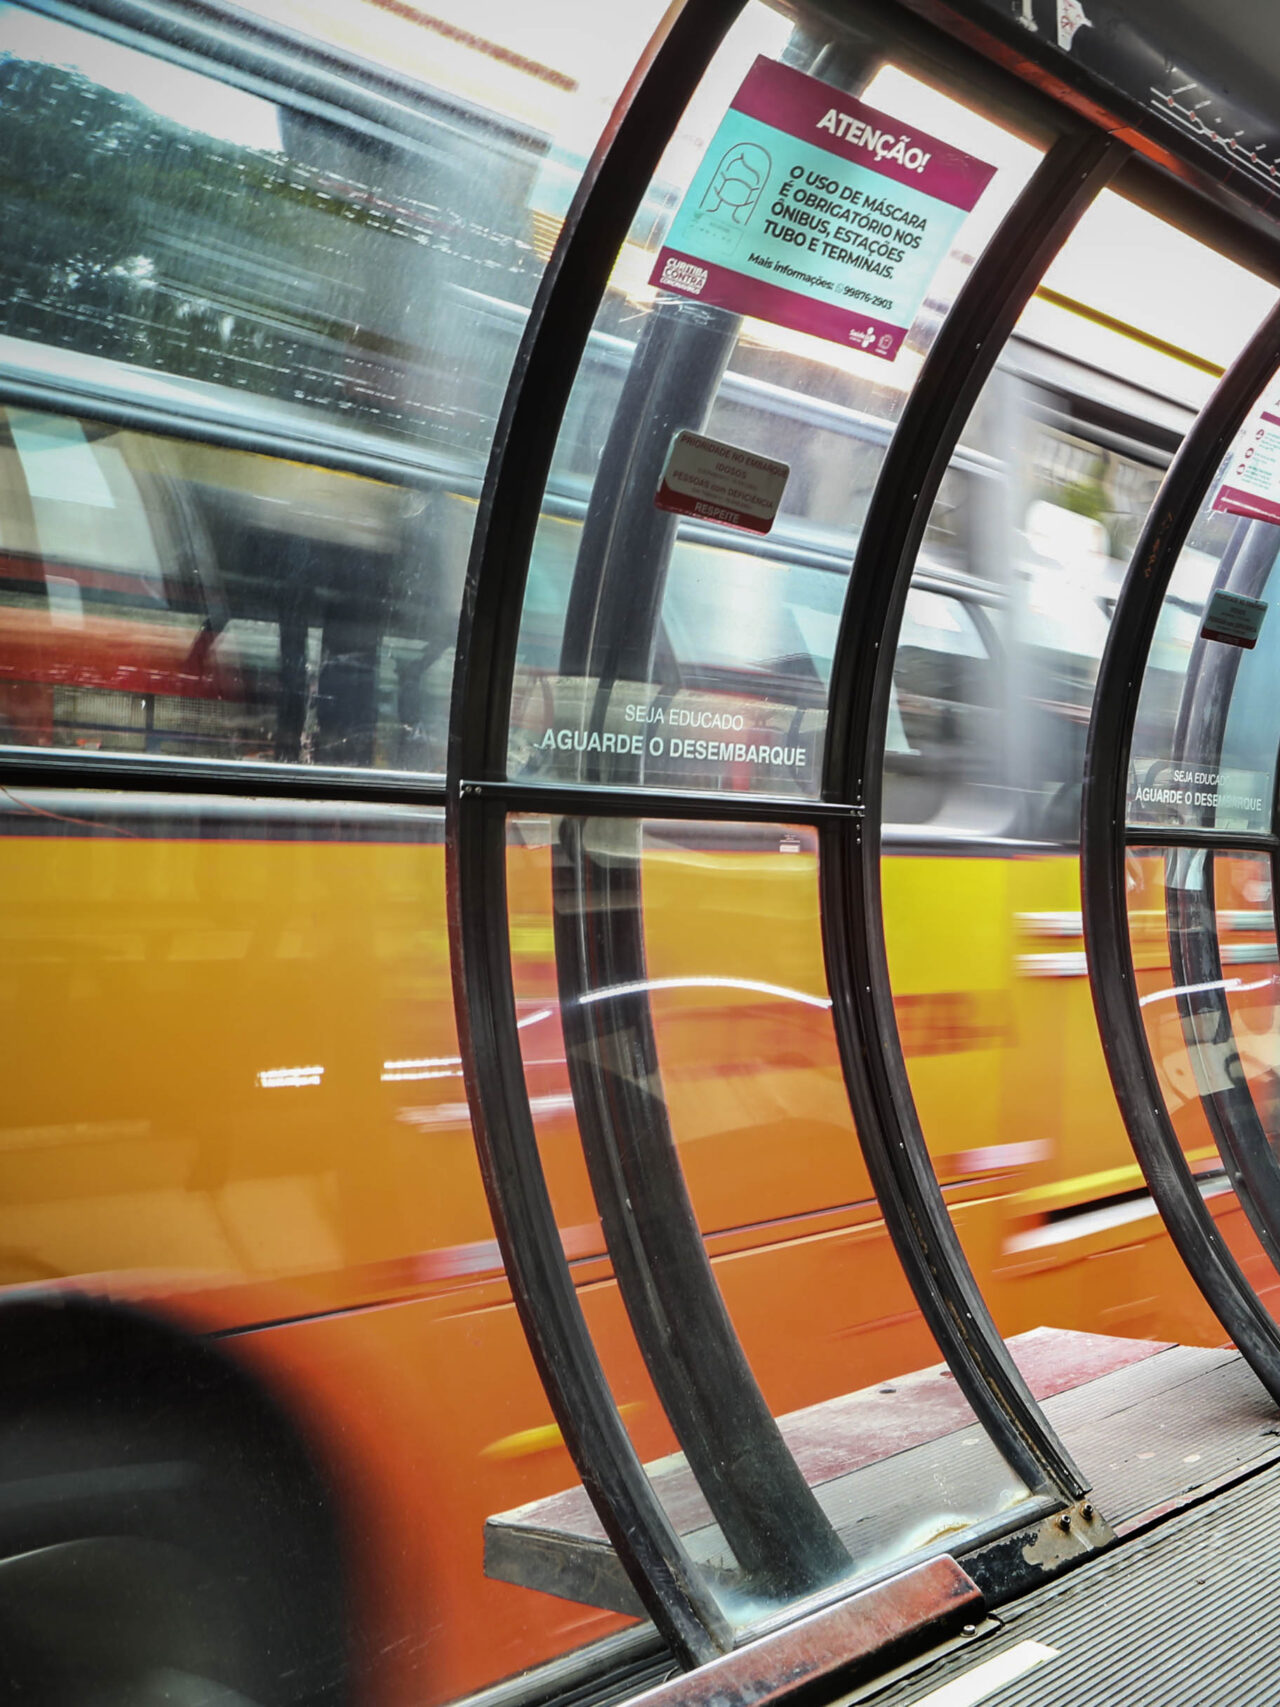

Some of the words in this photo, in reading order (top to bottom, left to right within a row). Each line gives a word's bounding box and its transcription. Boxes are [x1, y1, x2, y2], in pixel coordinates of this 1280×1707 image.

[816, 108, 931, 173] ATENÇÃO!
[790, 165, 804, 179] O
[805, 171, 839, 195] USO
[840, 186, 863, 205] DE
[862, 197, 928, 231] MÁSCARA
[779, 180, 794, 197] É
[793, 189, 893, 238] OBRIGATÓRIO
[893, 230, 922, 249] NOS
[771, 198, 831, 239] ÔNIBUS,
[833, 227, 905, 263] ESTAÇÕES
[763, 219, 806, 247] TUBO
[808, 238, 820, 252] E
[822, 241, 894, 279] TERMINAIS.
[664, 267, 704, 288] CONTRA
[666, 257, 708, 278] CURITIBA
[747, 252, 772, 269] Mais
[773, 261, 835, 291] informações:
[681, 435, 731, 458] PRIORIDADE
[731, 452, 745, 463] NO
[672, 470, 709, 489] PESSOAS
[715, 462, 747, 479] IDOSOS
[694, 502, 740, 524] RESPEITE
[625, 704, 665, 724] SEJA
[669, 709, 744, 732] EDUCADO
[541, 728, 644, 755] AGUARDE
[649, 737, 664, 756] O
[669, 738, 806, 767] DESEMBARQUE
[1173, 770, 1193, 783] SEJA
[1194, 772, 1229, 786] EDUCAD
[1135, 788, 1183, 804] AGUARDE
[1185, 791, 1193, 804] O
